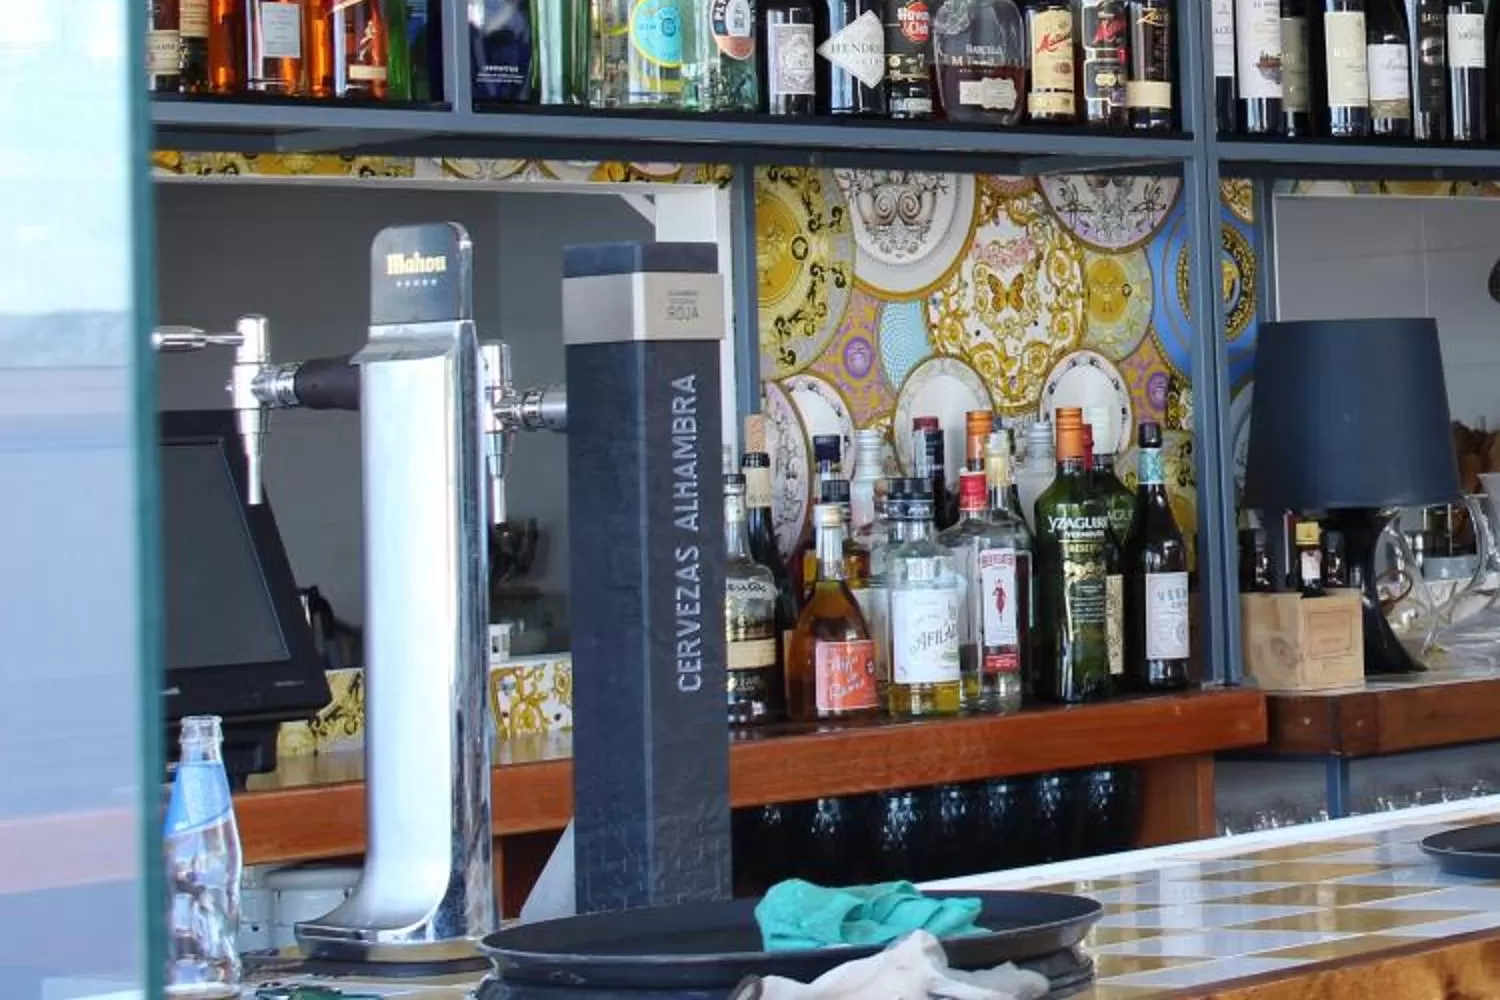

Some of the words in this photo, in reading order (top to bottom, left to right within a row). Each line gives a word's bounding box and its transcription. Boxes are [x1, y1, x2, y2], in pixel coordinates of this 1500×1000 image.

[387, 250, 447, 274] Mahou
[671, 373, 699, 532] ALHAMBRA
[675, 547, 701, 693] CERVEZAS
